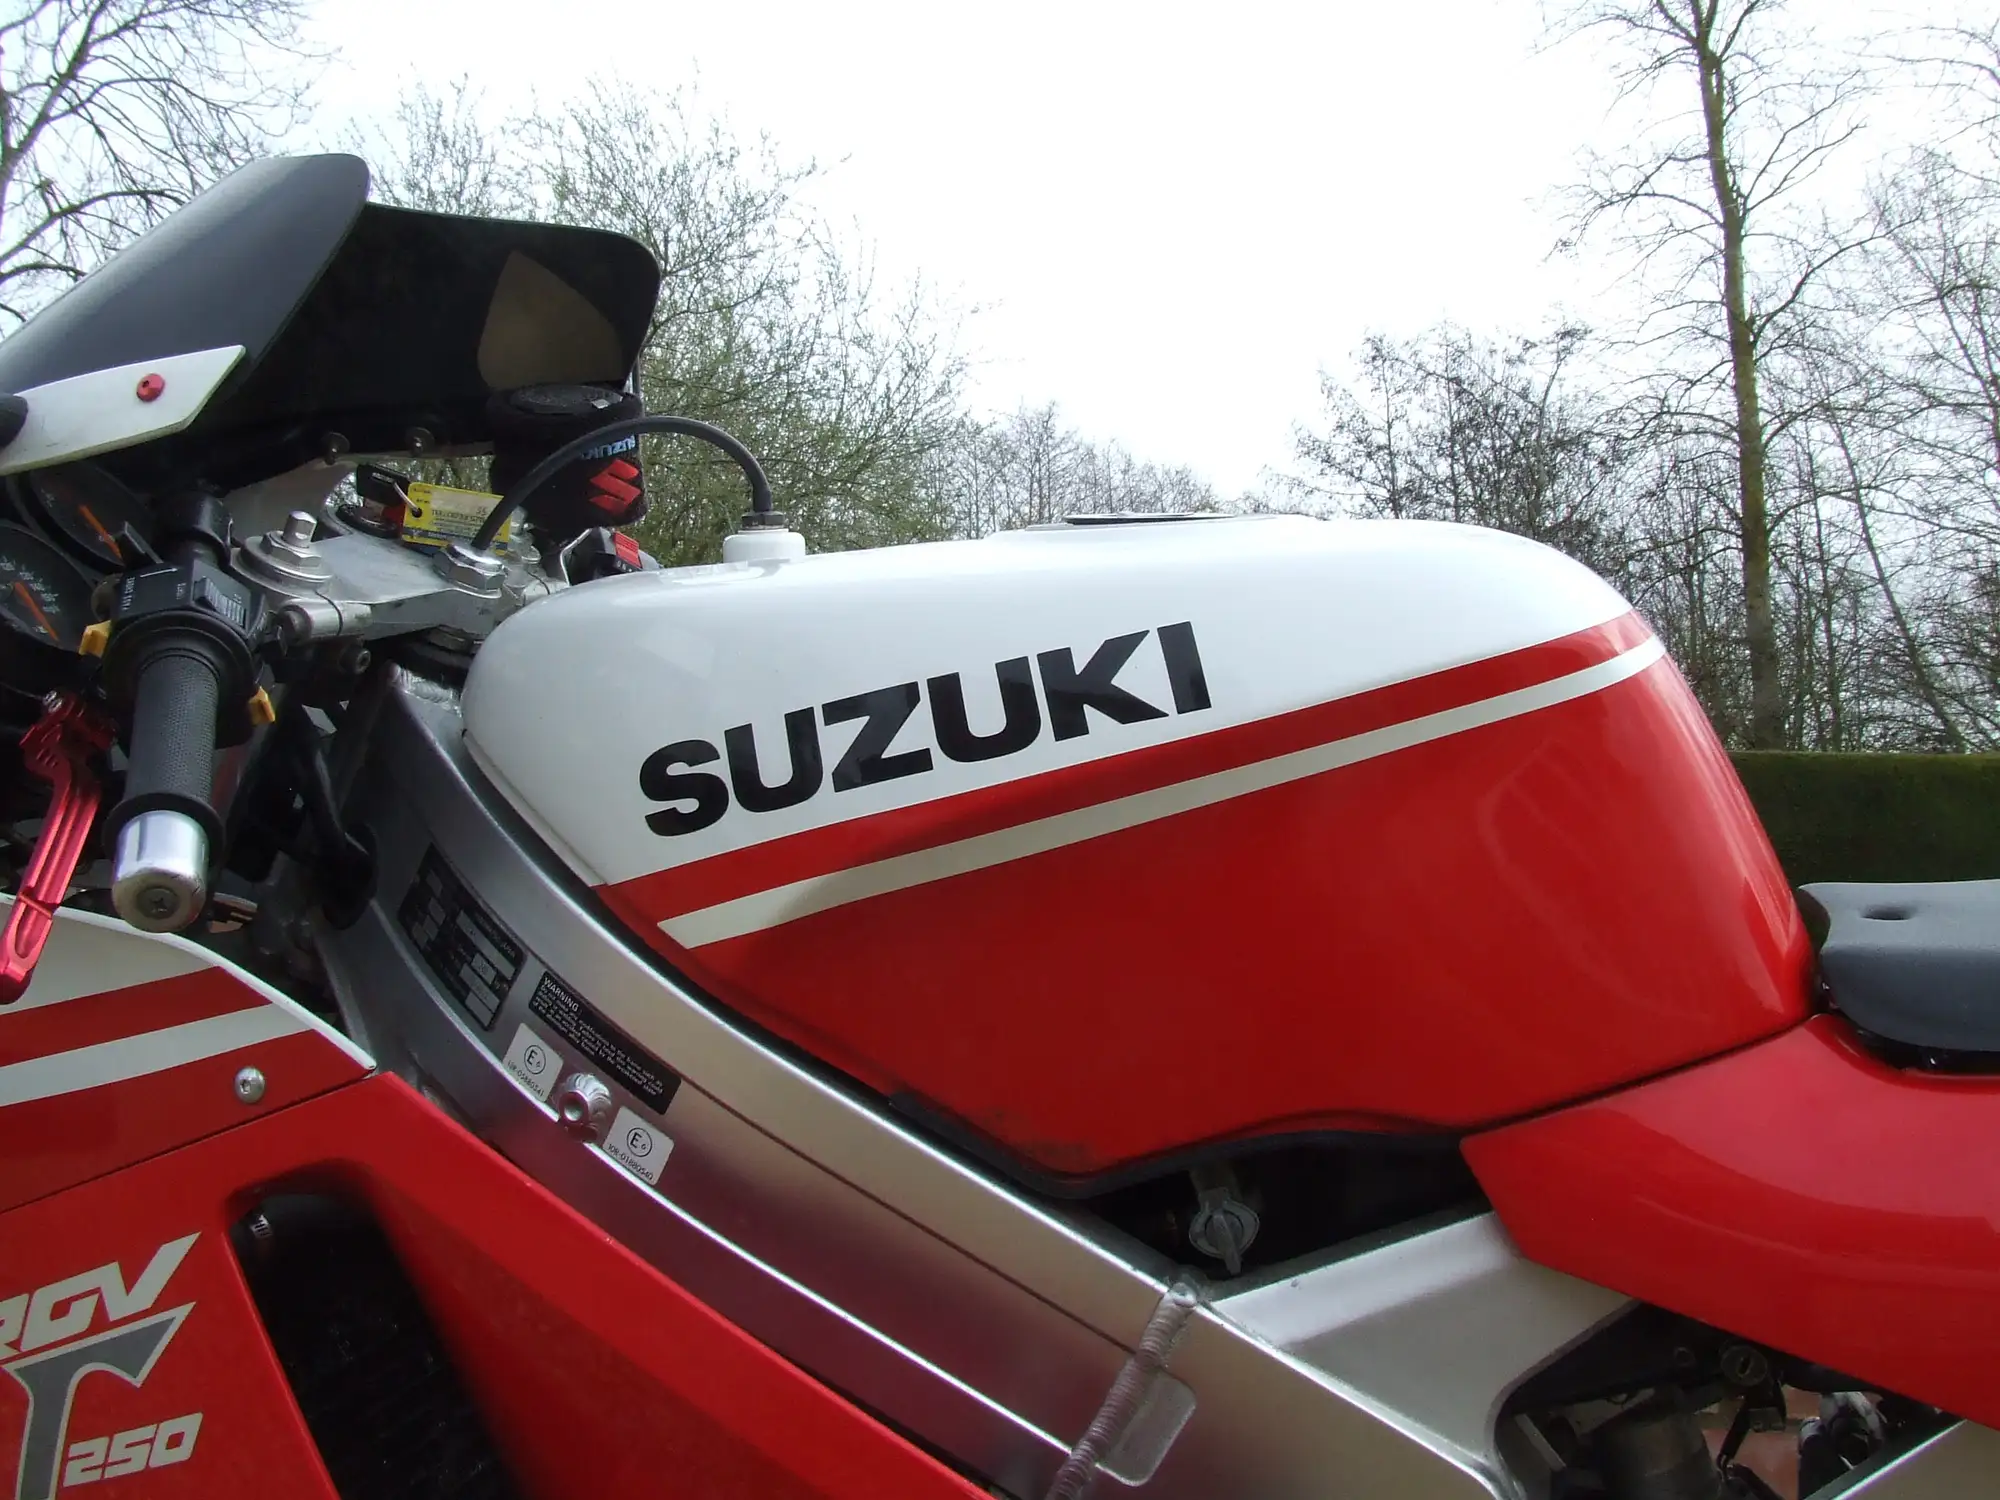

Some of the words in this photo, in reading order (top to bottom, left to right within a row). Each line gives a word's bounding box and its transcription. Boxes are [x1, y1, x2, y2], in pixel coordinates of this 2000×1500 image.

[640, 621, 1212, 836] SUZUKI
[543, 977, 579, 1012] WARNING
[63, 1412, 203, 1487] 250
